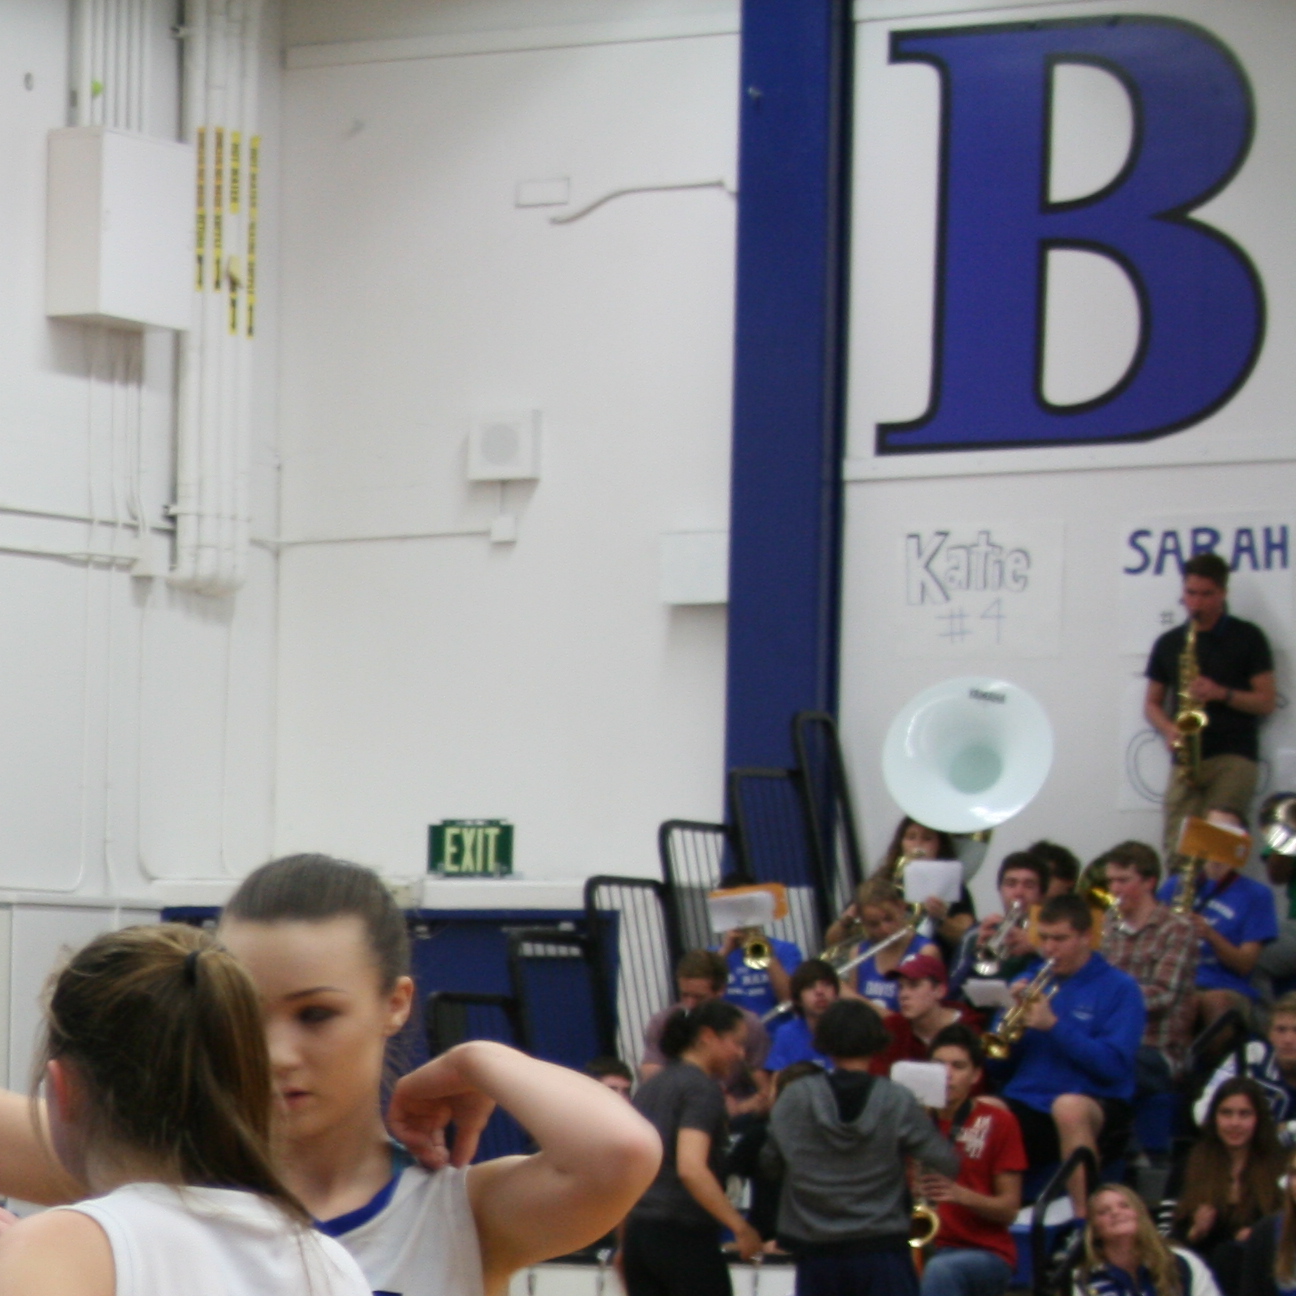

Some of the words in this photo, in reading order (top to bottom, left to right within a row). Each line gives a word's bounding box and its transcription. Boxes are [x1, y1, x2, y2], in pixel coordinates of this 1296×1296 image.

[875, 14, 1267, 456] B
[907, 530, 1031, 604] Katie
[1123, 525, 1289, 576] SARAH
[934, 597, 1007, 644] #4
